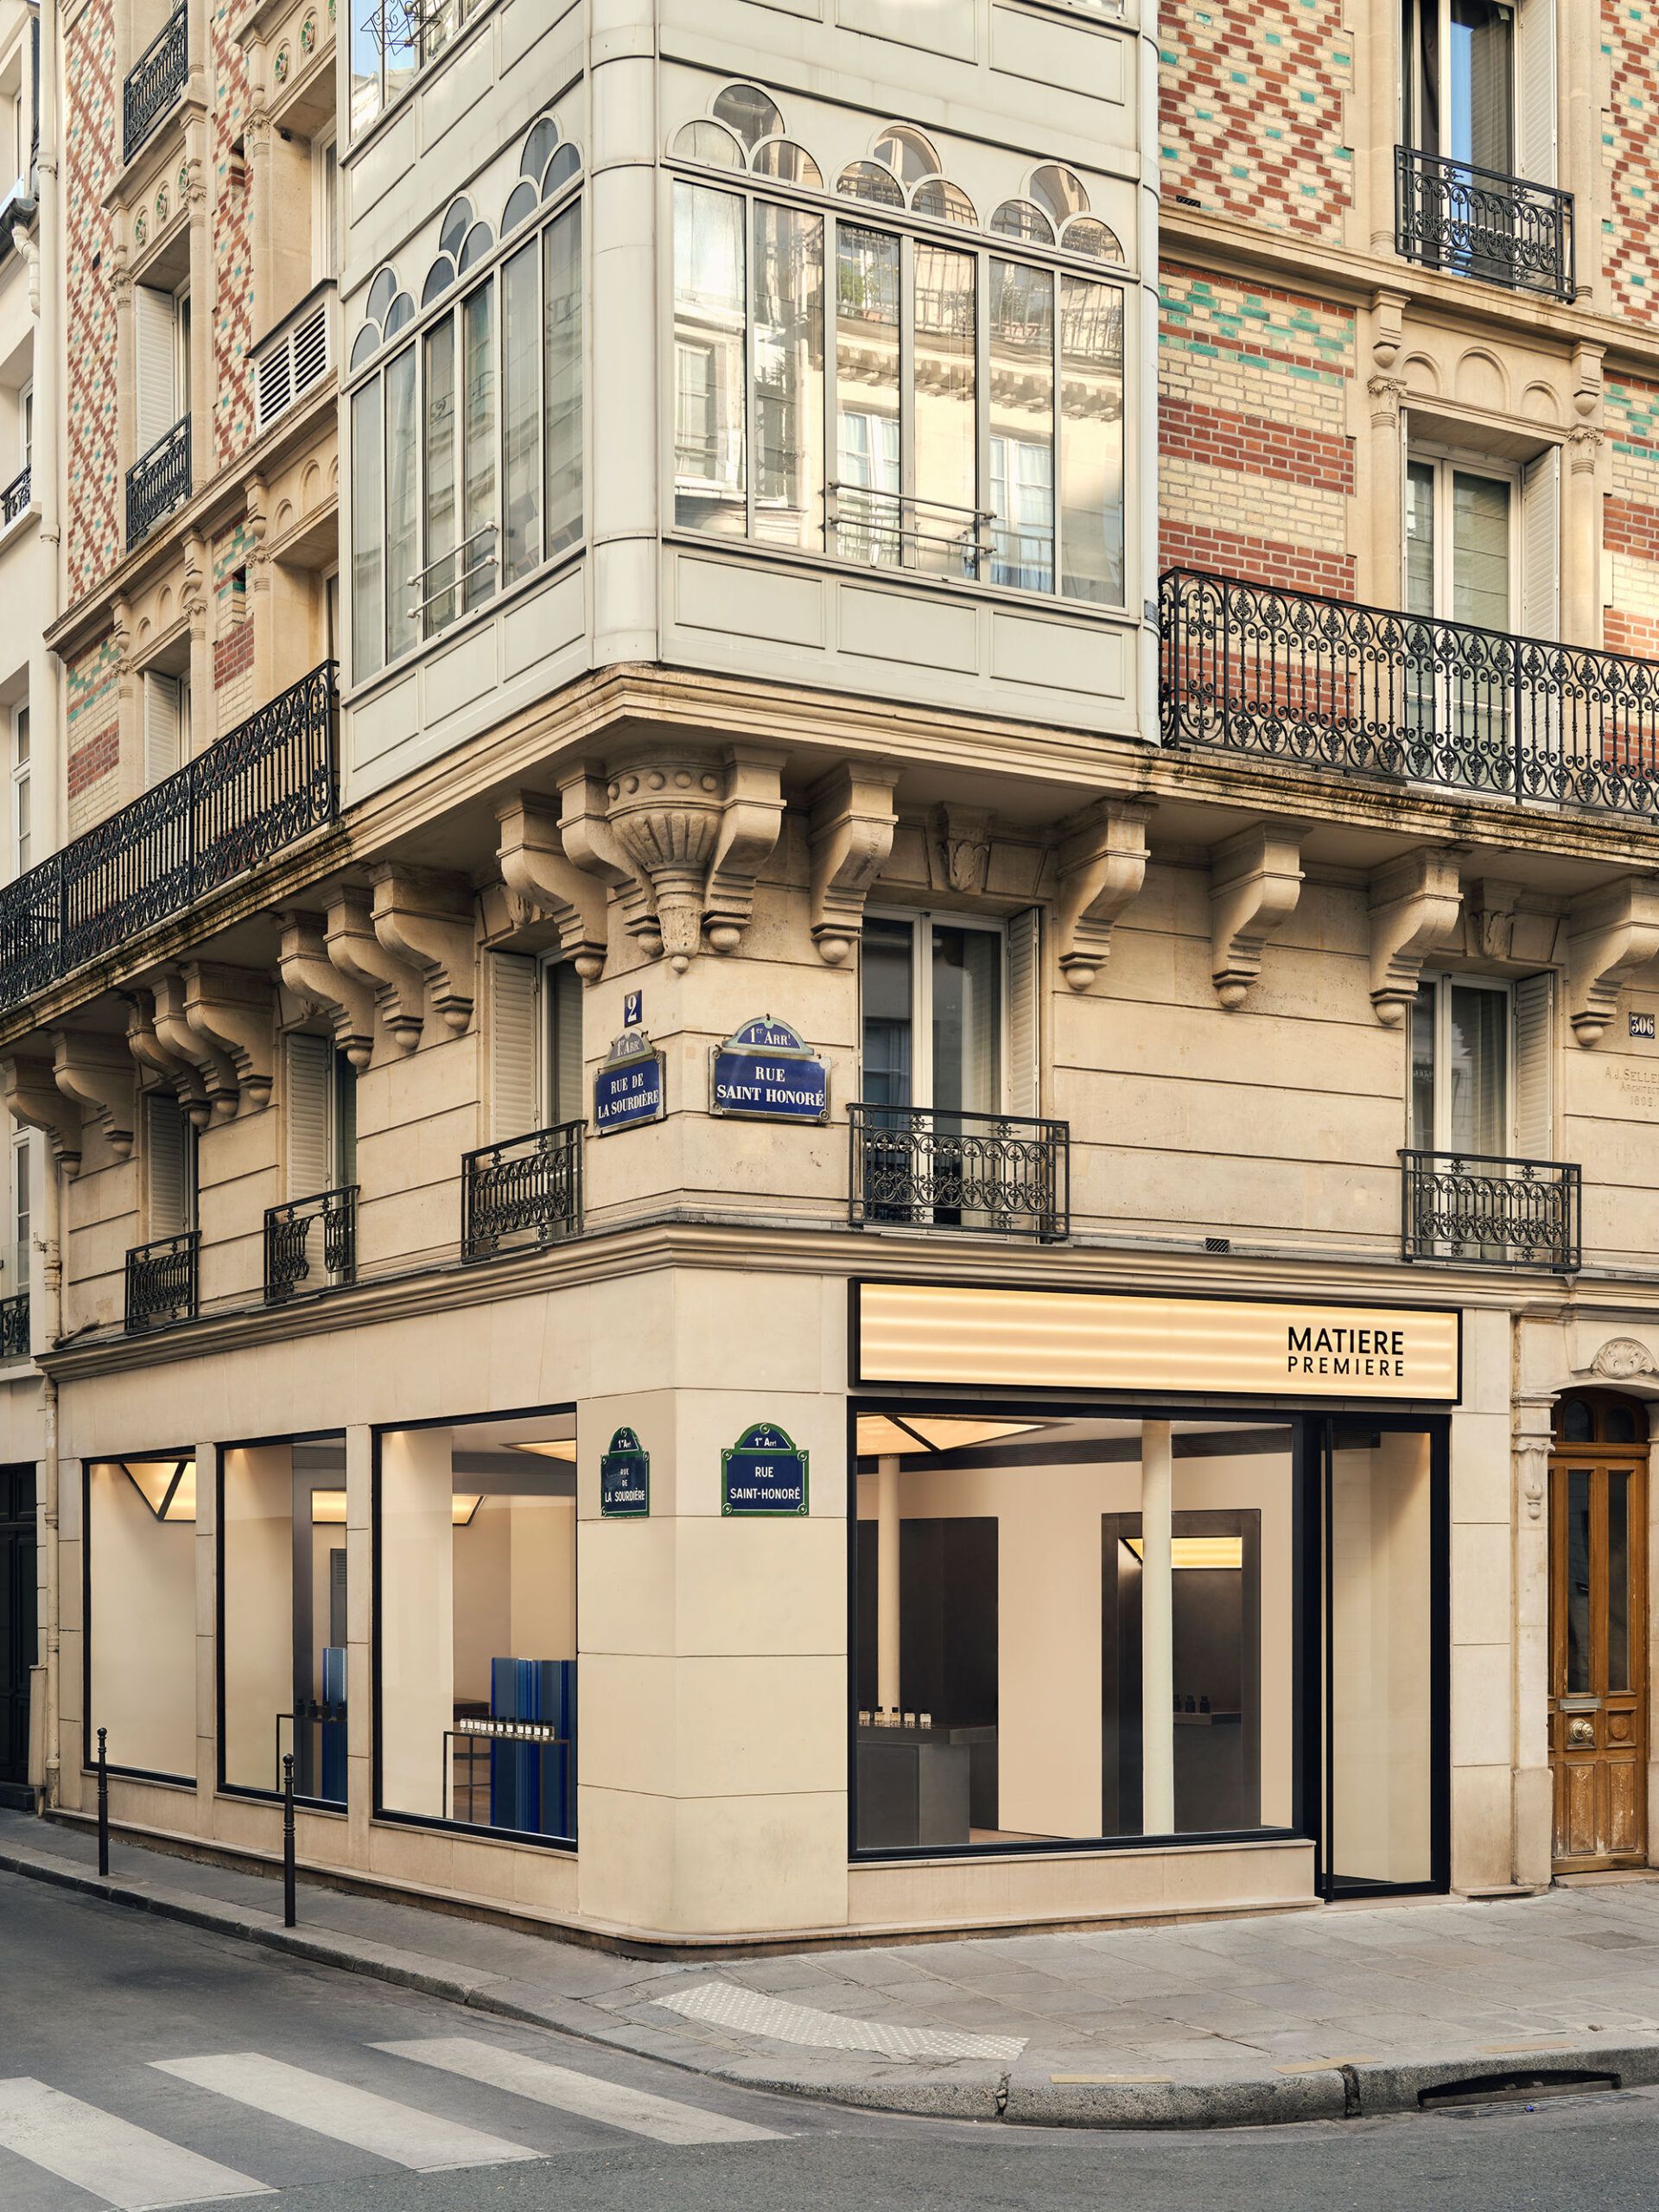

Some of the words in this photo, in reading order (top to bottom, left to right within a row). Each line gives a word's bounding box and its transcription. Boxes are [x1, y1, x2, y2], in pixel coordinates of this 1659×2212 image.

[627, 995, 637, 1023] 2
[1630, 1015, 1654, 1035] 306
[611, 1077, 628, 1095] RUE
[632, 1072, 644, 1090] DE
[755, 1065, 785, 1083] RUE
[598, 1105, 610, 1120] LA
[611, 1090, 659, 1116] SOURDIÈRE
[716, 1084, 761, 1102] SAINT
[766, 1090, 824, 1107] HONORÉ
[1287, 1326, 1404, 1356] MATIERE
[1287, 1356, 1404, 1376] PREMIERE
[755, 1466, 774, 1478] RUE
[605, 1491, 612, 1503] LA
[614, 1487, 645, 1502] SOURDIÈRE
[730, 1486, 801, 1499] SAINT-HONORÉ
